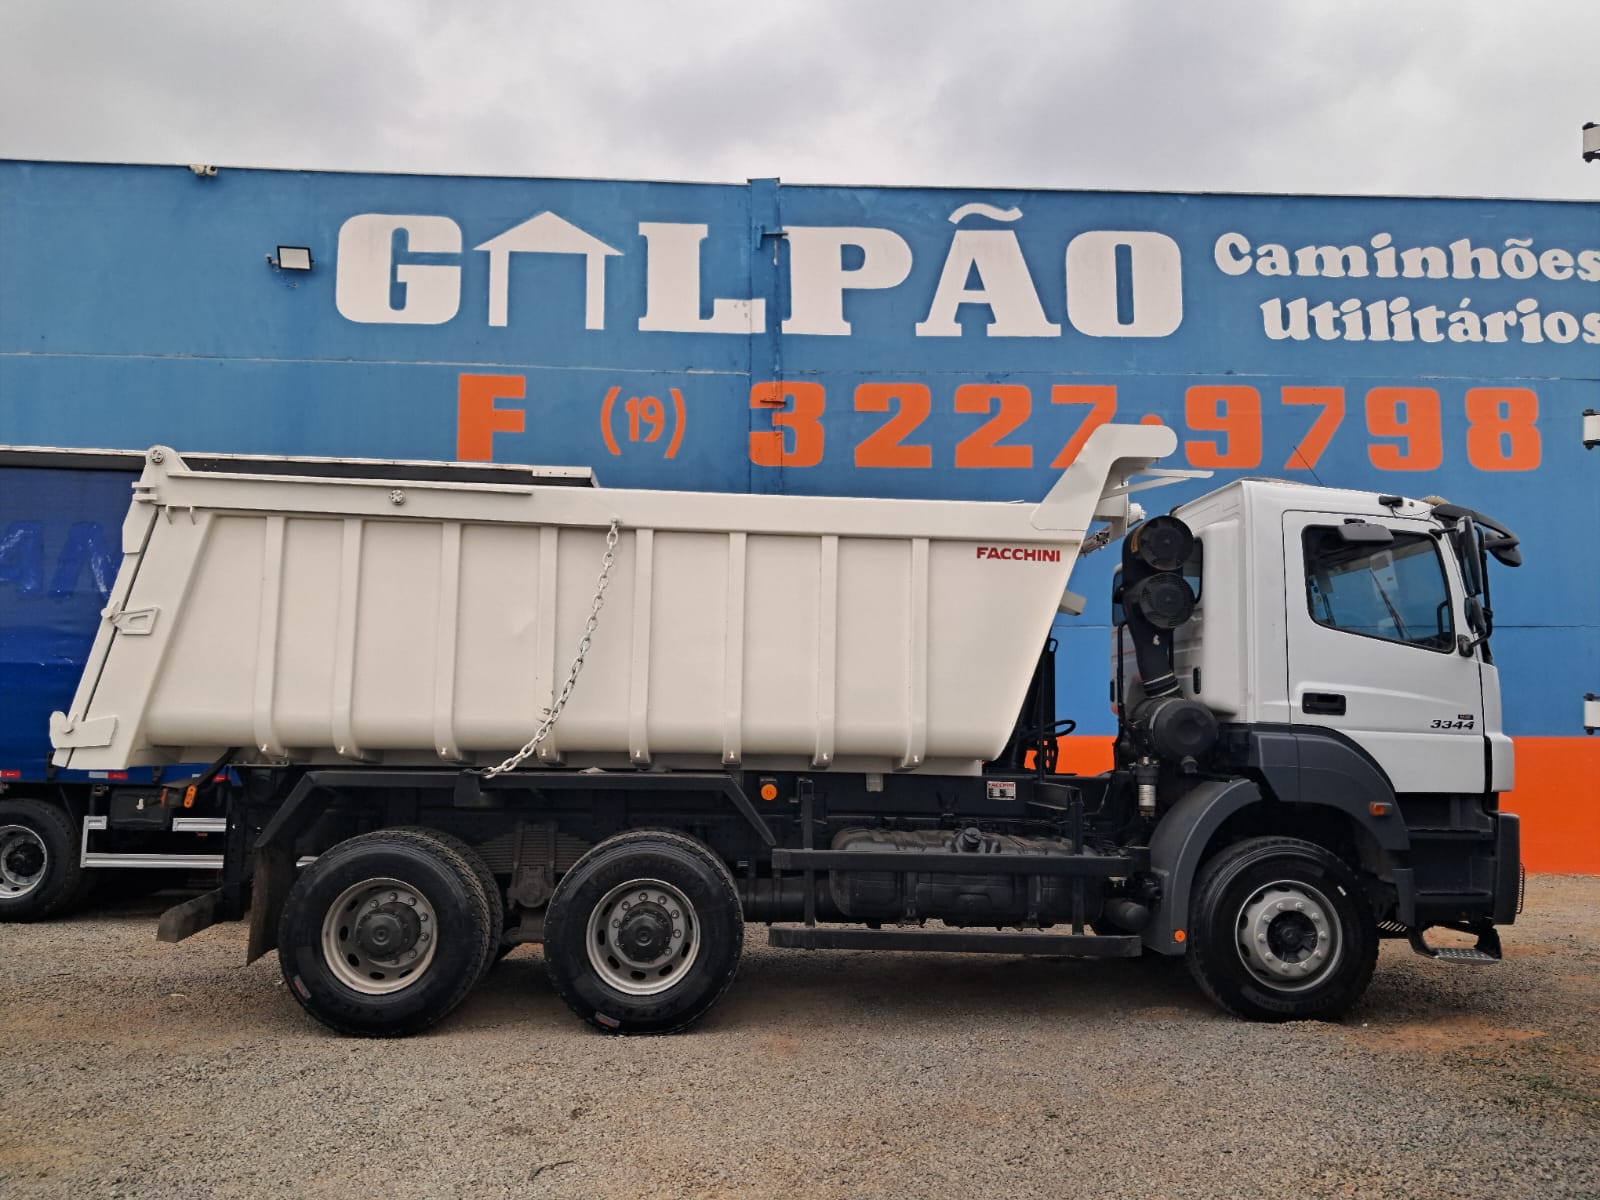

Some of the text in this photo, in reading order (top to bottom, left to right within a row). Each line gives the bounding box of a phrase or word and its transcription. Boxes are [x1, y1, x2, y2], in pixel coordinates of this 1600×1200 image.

[1214, 232, 1600, 282] Caminhões
[1259, 297, 1600, 344] Utilitários
[456, 373, 526, 462] F
[600, 386, 686, 459] (19)
[976, 547, 1061, 562] FACCHINI
[1430, 719, 1475, 730] 3344
